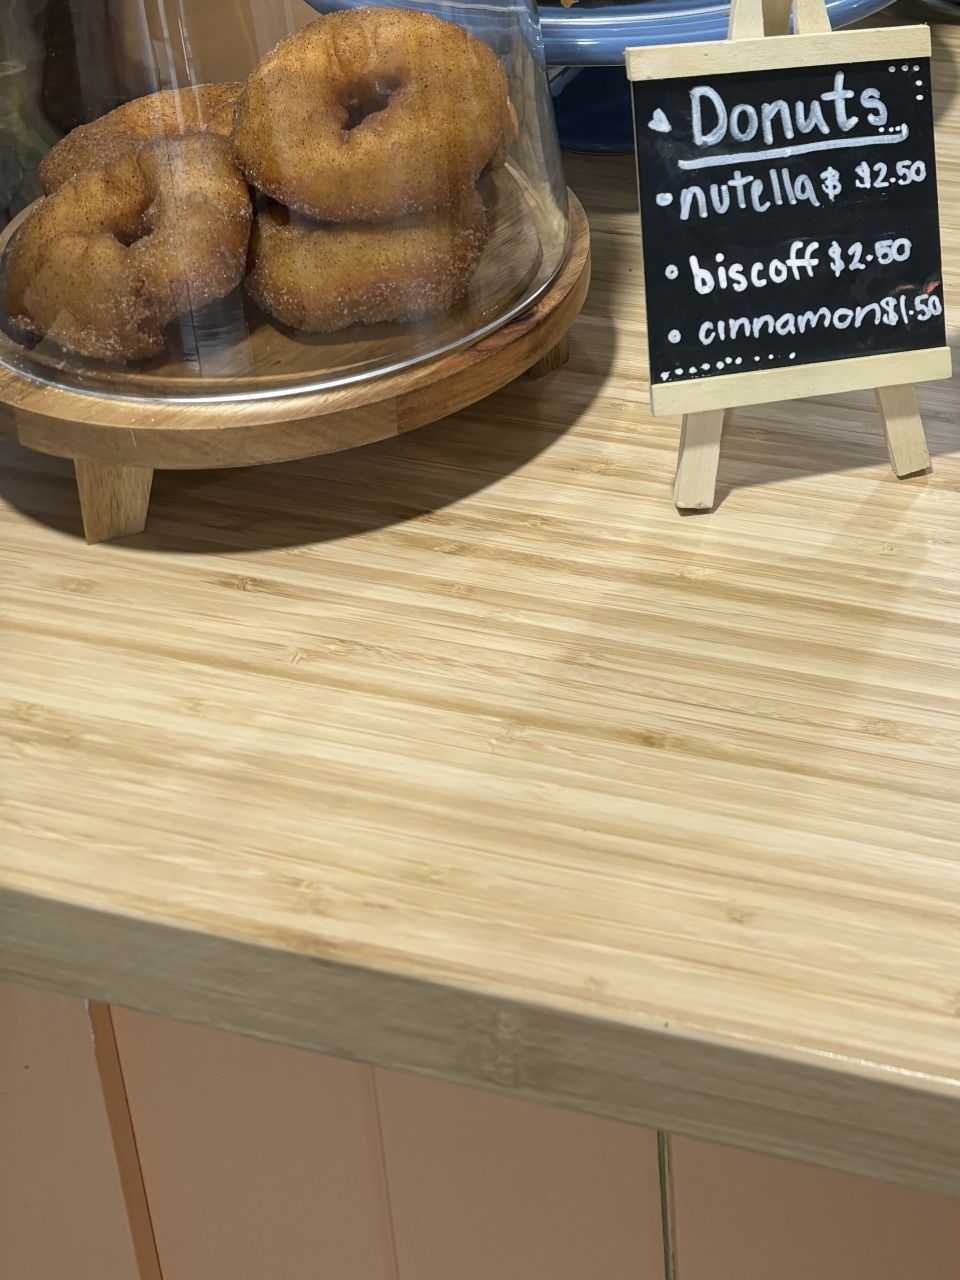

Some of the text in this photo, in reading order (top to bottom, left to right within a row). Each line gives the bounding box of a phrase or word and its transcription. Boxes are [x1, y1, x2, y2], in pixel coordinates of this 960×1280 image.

[690, 71, 888, 146] Donuts
[855, 159, 927, 190] $2.50
[689, 237, 912, 295] biscoff $2.50
